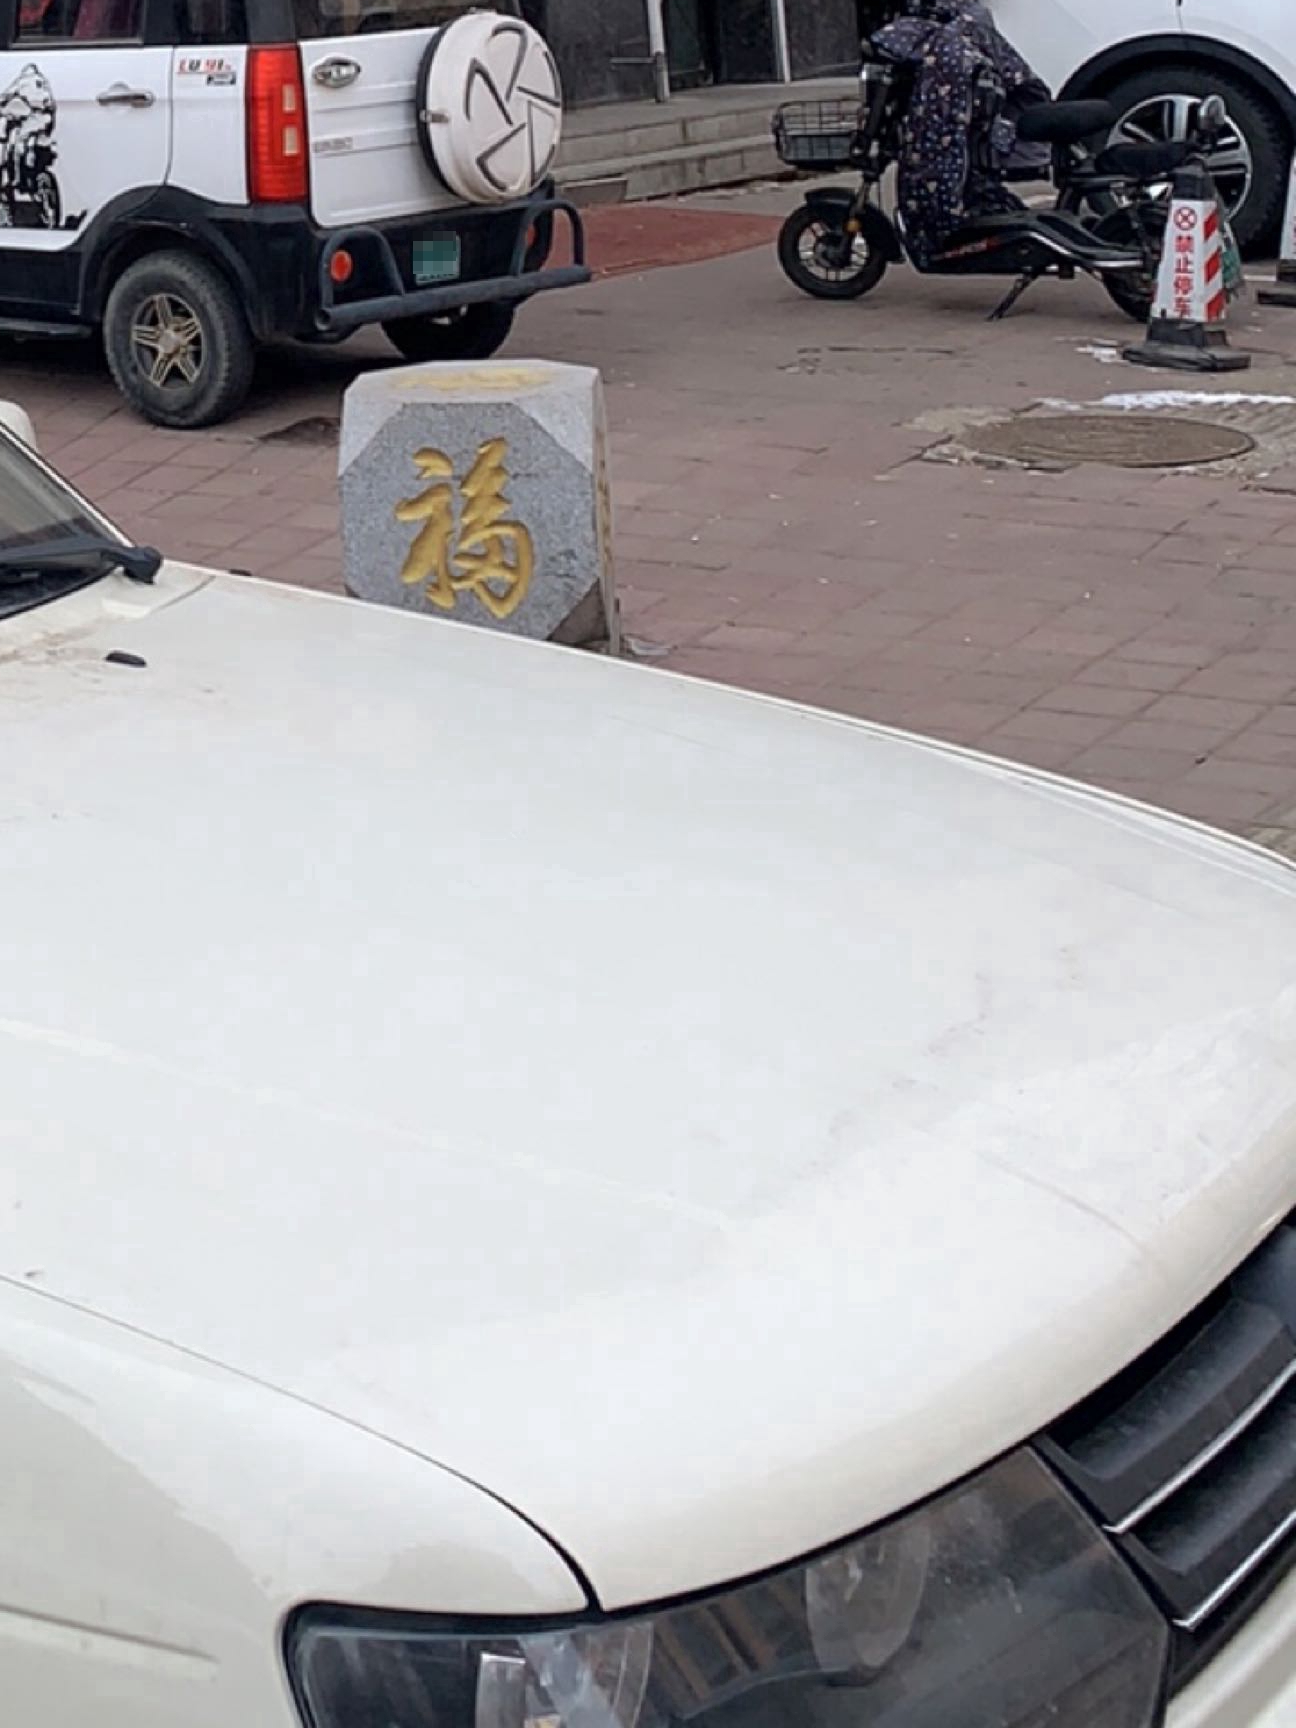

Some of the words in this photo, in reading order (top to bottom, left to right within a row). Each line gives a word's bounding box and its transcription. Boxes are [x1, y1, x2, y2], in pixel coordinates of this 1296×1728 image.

[1173, 234, 1195, 320] 禁止停车
[394, 436, 536, 619] 福
